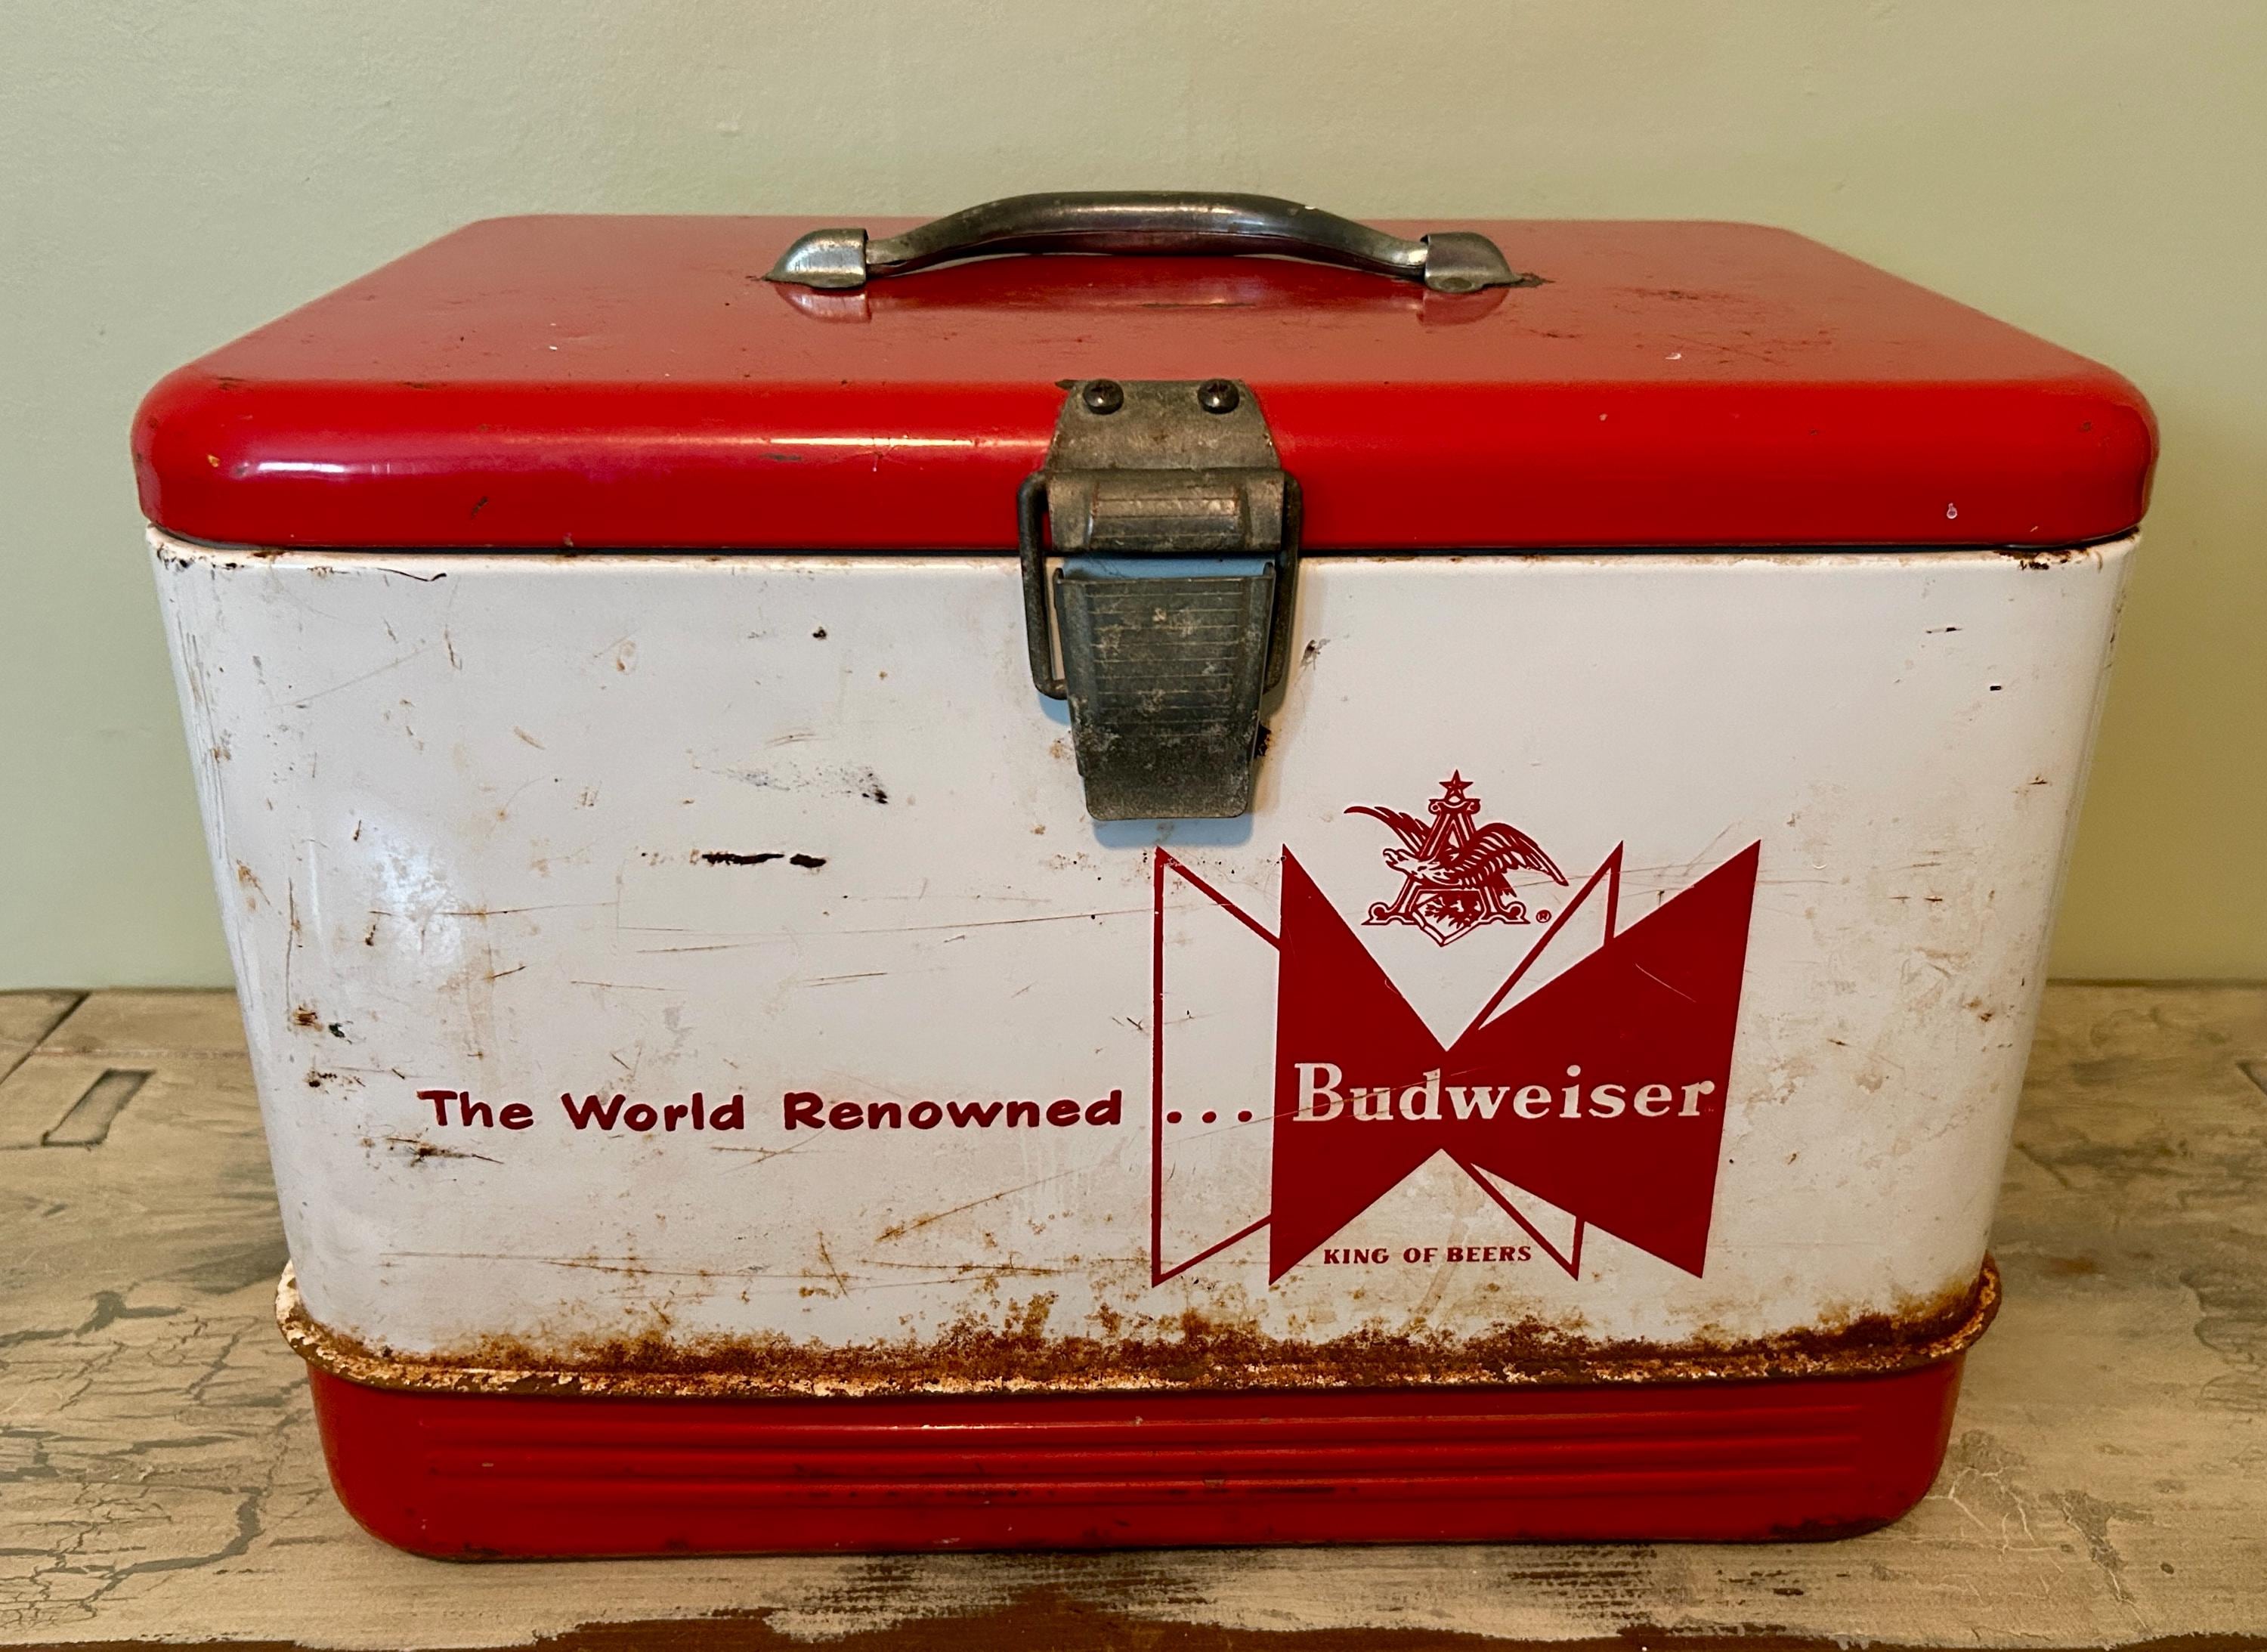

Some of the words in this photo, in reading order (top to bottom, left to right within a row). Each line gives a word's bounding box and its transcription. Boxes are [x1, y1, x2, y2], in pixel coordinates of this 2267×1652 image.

[416, 1090, 534, 1129] The
[561, 1093, 744, 1131] World
[784, 1090, 1123, 1131] Renowned
[1292, 1062, 1717, 1123] Budweiser
[1323, 1248, 1389, 1264] KING
[1403, 1248, 1439, 1264] OF
[1447, 1245, 1532, 1263] BEERS
